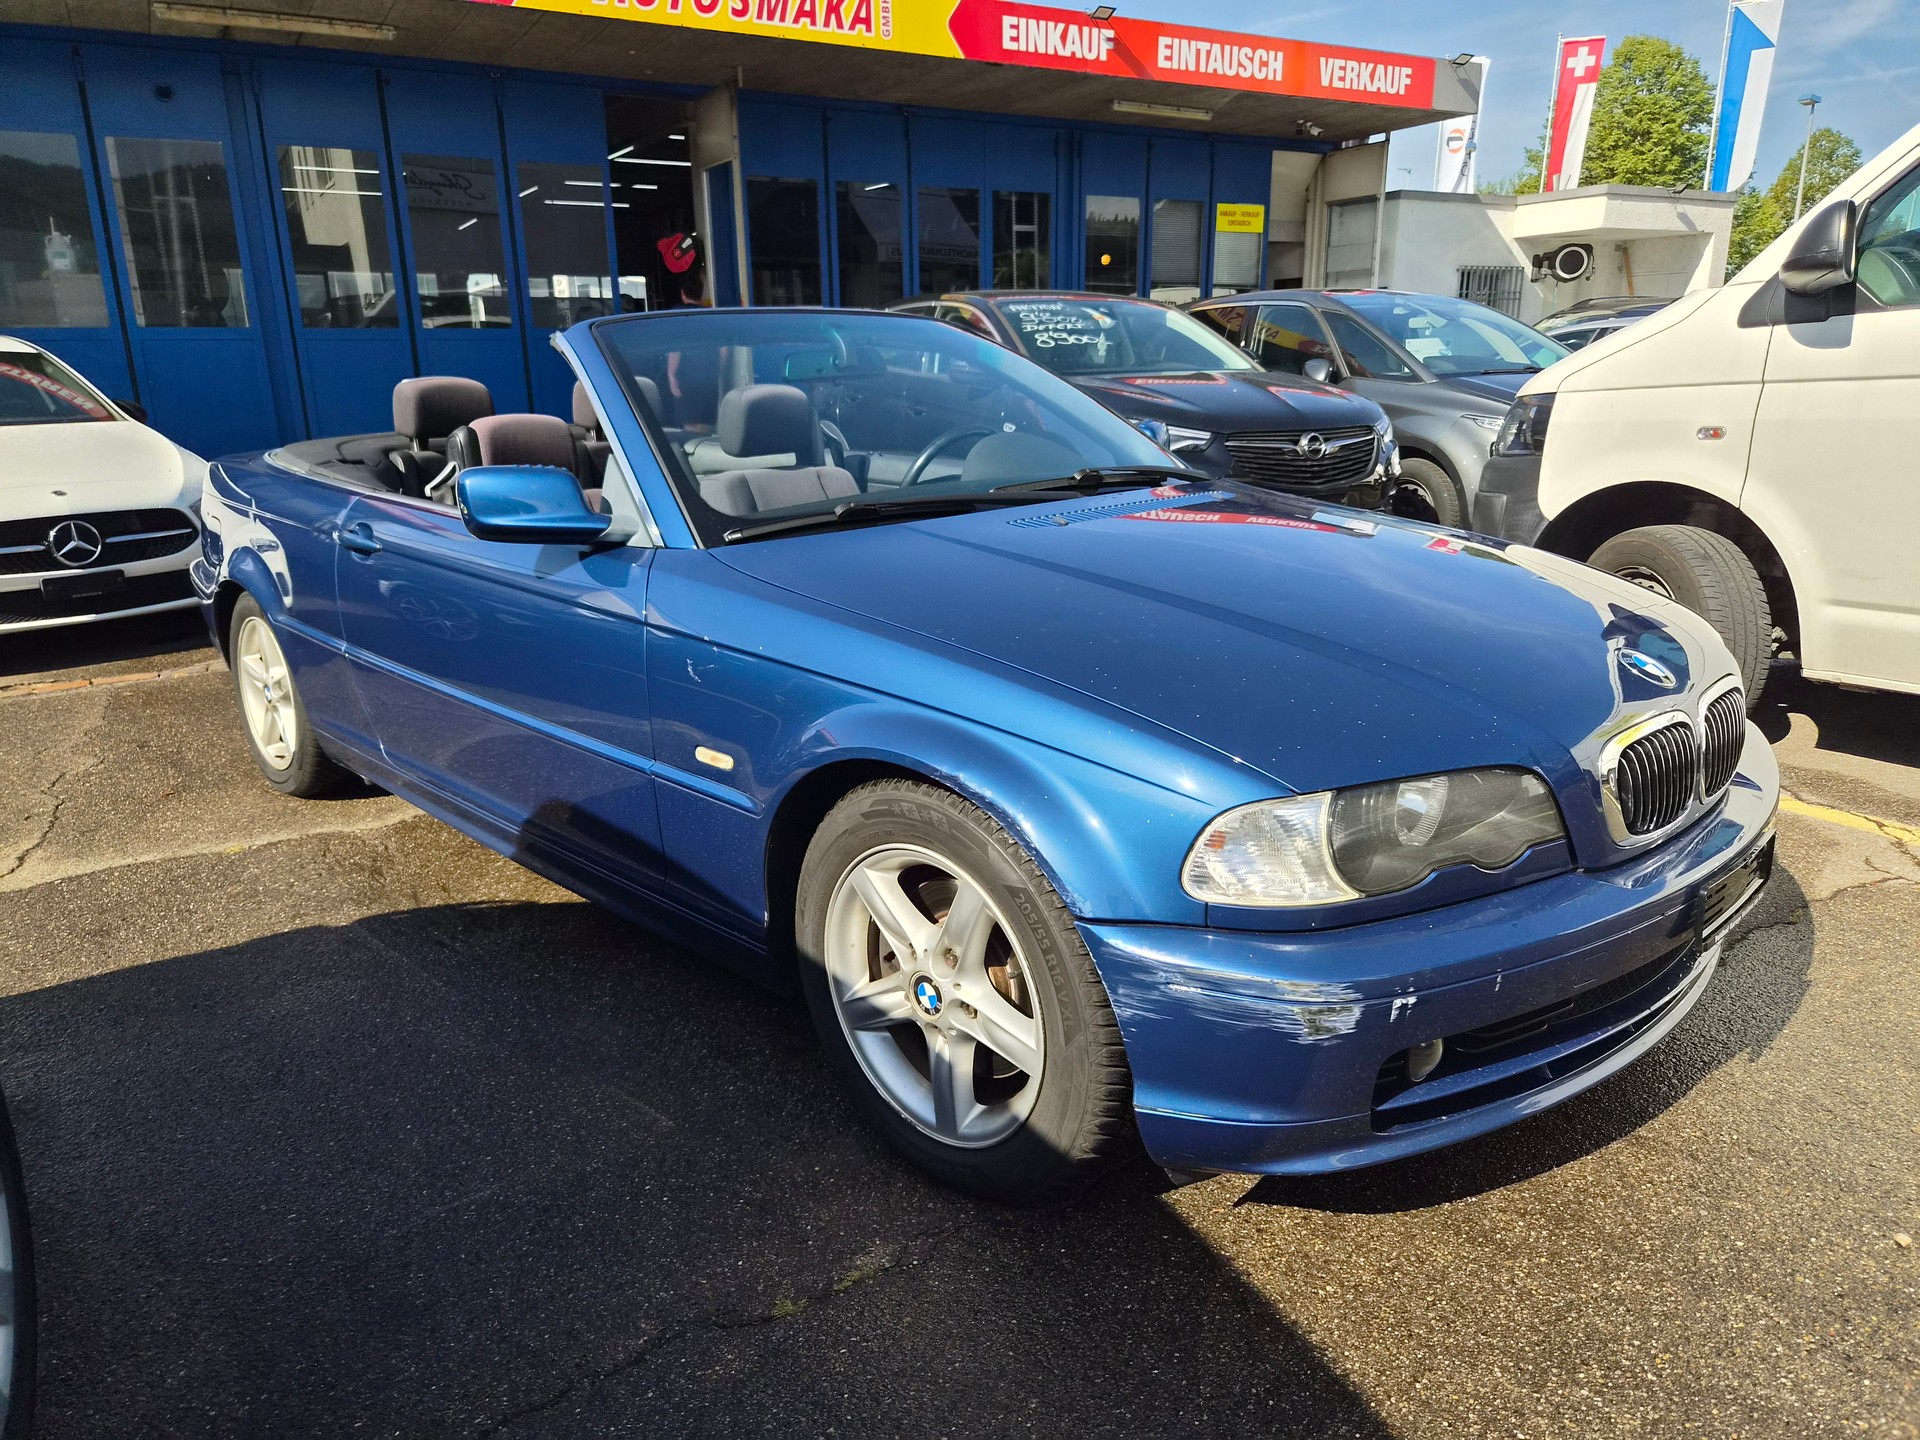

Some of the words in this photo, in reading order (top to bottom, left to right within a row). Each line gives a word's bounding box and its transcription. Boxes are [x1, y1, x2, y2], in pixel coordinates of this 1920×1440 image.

[1001, 15, 1115, 62] EINKAUF
[1157, 36, 1284, 82] EINTAUSCH
[1319, 57, 1412, 96] VERKAUF
[1219, 210, 1237, 218] ANKAUF
[1241, 211, 1260, 219] VERKAUF
[1227, 219, 1252, 227] EINTAUSCH
[1013, 892, 1051, 950] 205/55
[1044, 953, 1065, 987] R16
